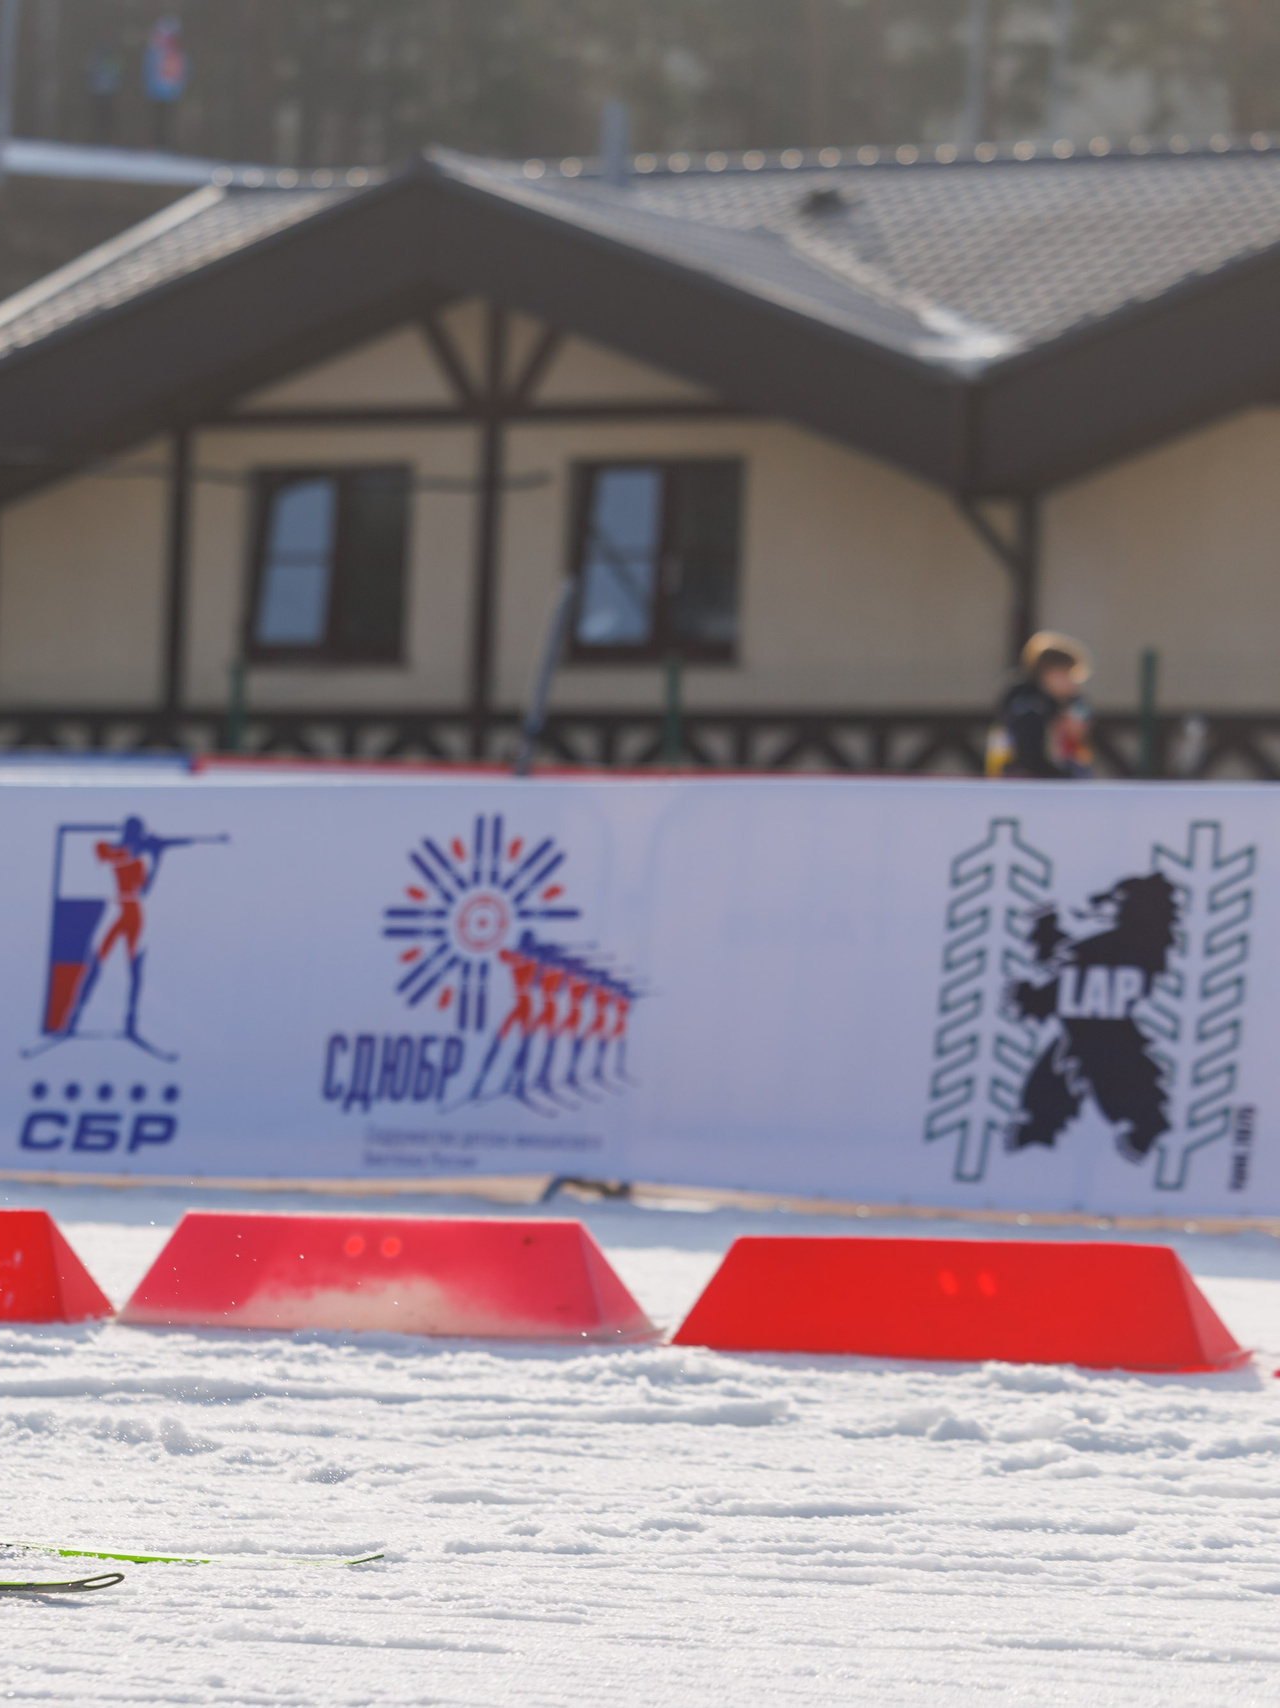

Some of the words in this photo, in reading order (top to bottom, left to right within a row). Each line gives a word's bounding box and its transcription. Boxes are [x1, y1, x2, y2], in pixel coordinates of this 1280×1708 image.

[1057, 963, 1145, 1020] LAP
[322, 1032, 466, 1113] СДЮБР
[19, 1111, 180, 1154] СБР
